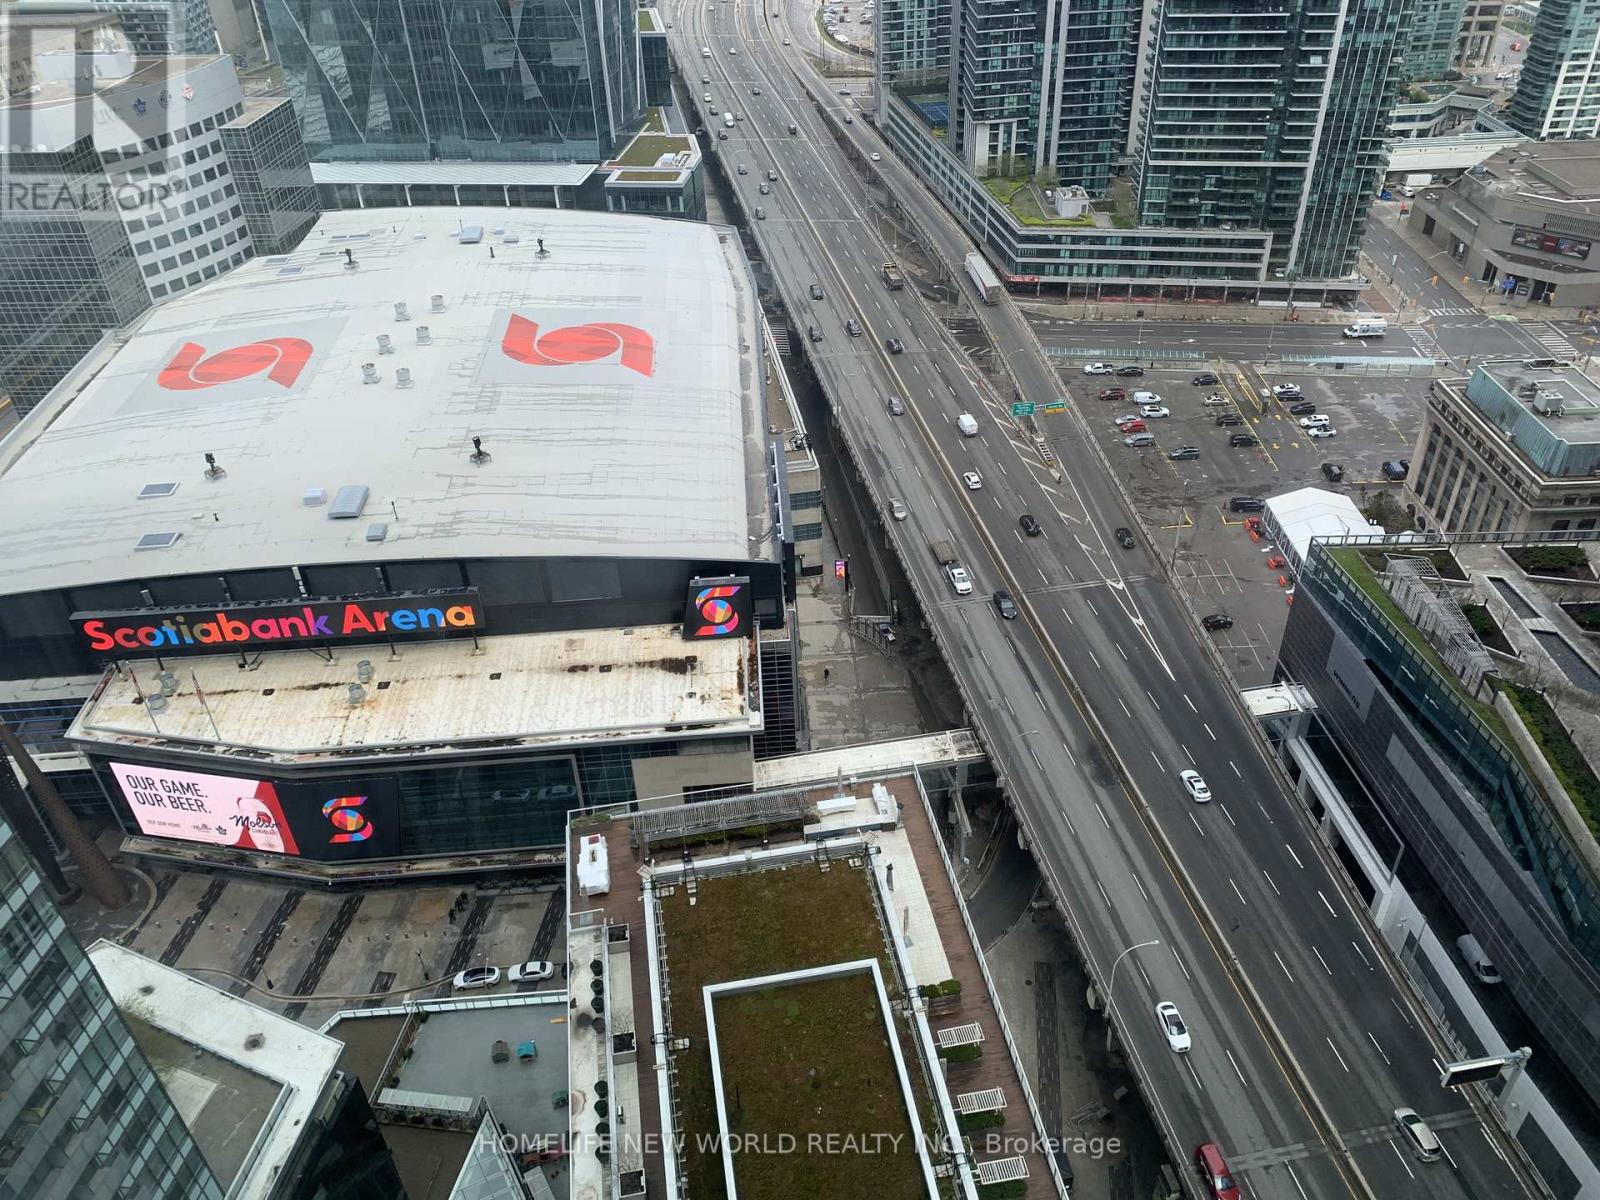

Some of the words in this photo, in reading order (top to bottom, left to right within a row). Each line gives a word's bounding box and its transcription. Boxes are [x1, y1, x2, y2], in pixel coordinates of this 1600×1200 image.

[83, 606, 334, 651] Scotiabank
[341, 603, 476, 635] Arena
[125, 774, 158, 792] OUR
[160, 779, 208, 798] GAME.
[133, 791, 167, 808] OUR
[166, 795, 213, 814] BEER.
